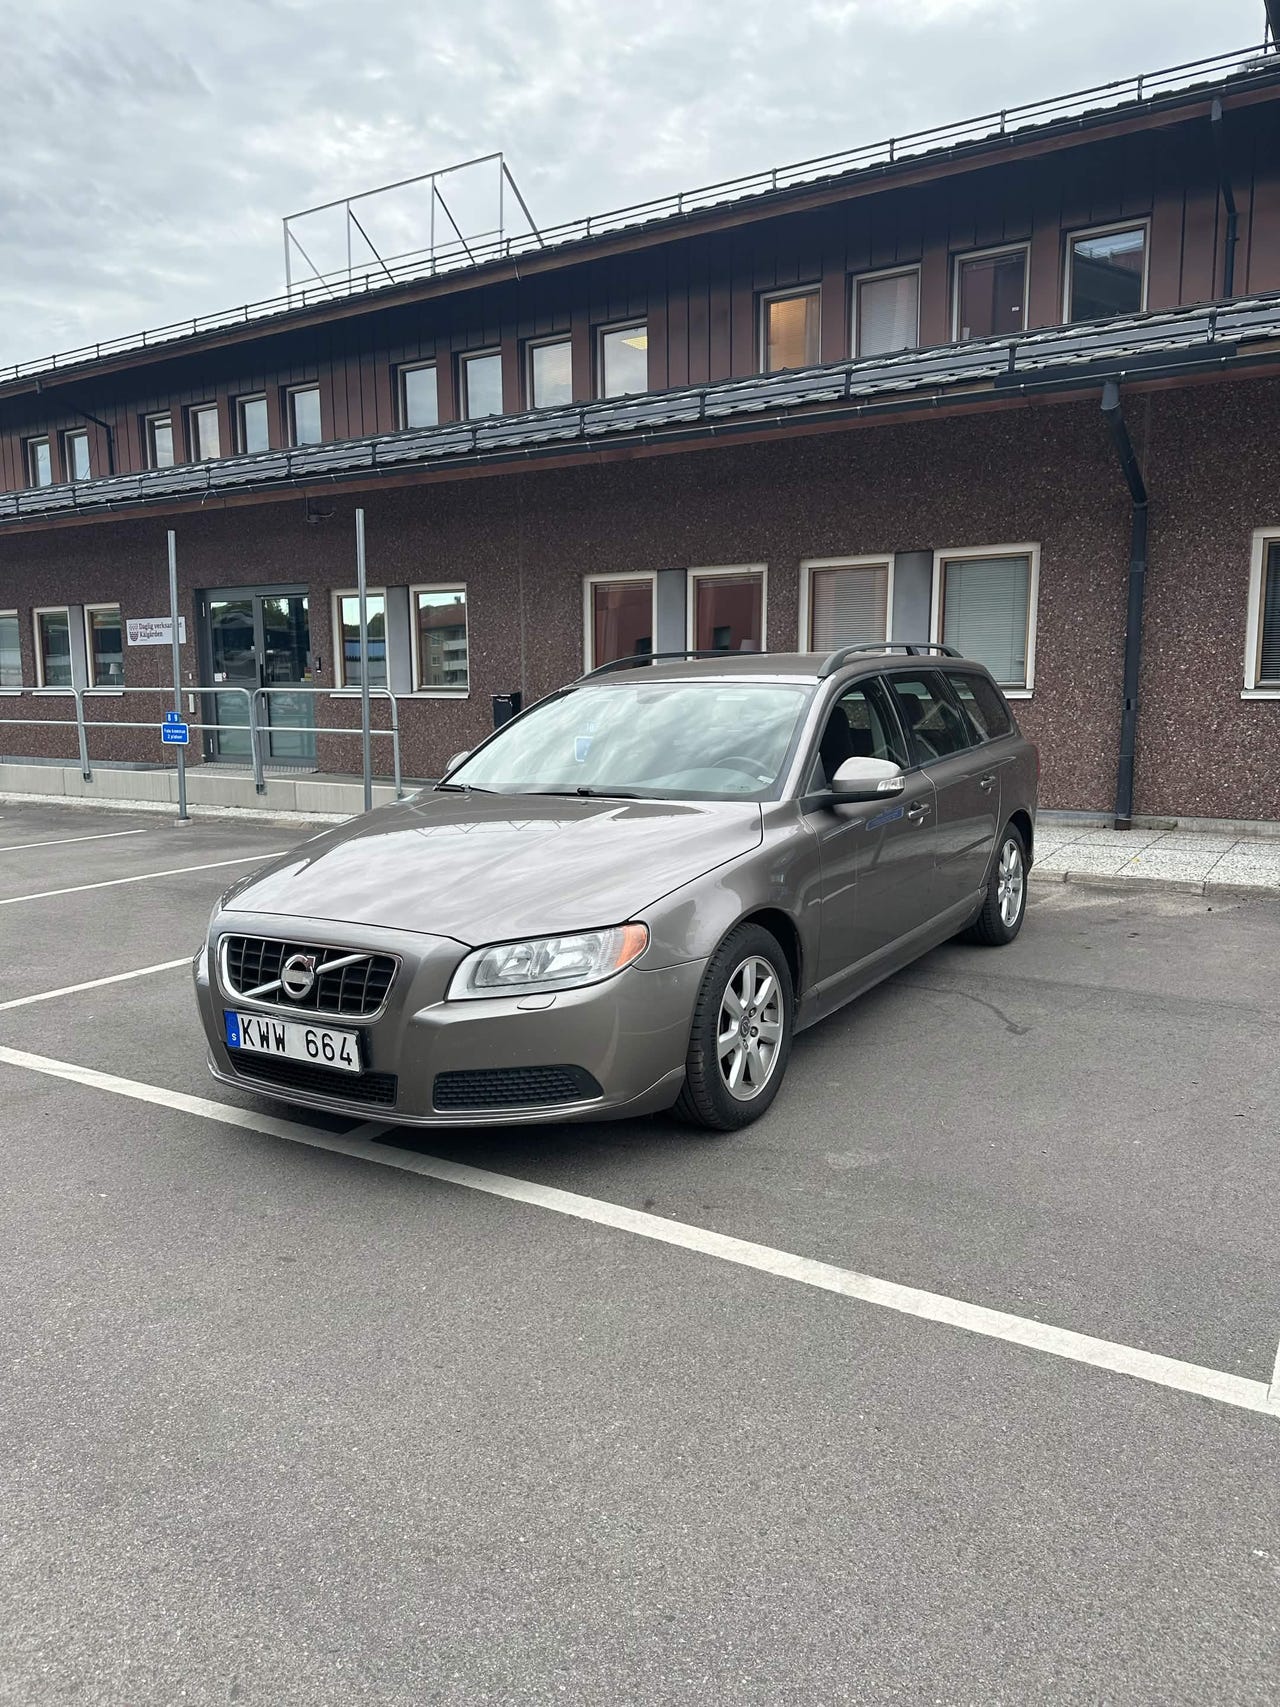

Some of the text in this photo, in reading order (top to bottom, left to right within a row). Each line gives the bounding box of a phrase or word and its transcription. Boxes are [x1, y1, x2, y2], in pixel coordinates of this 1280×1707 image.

[231, 1032, 237, 1041] S
[241, 1017, 353, 1066] KWW 664
